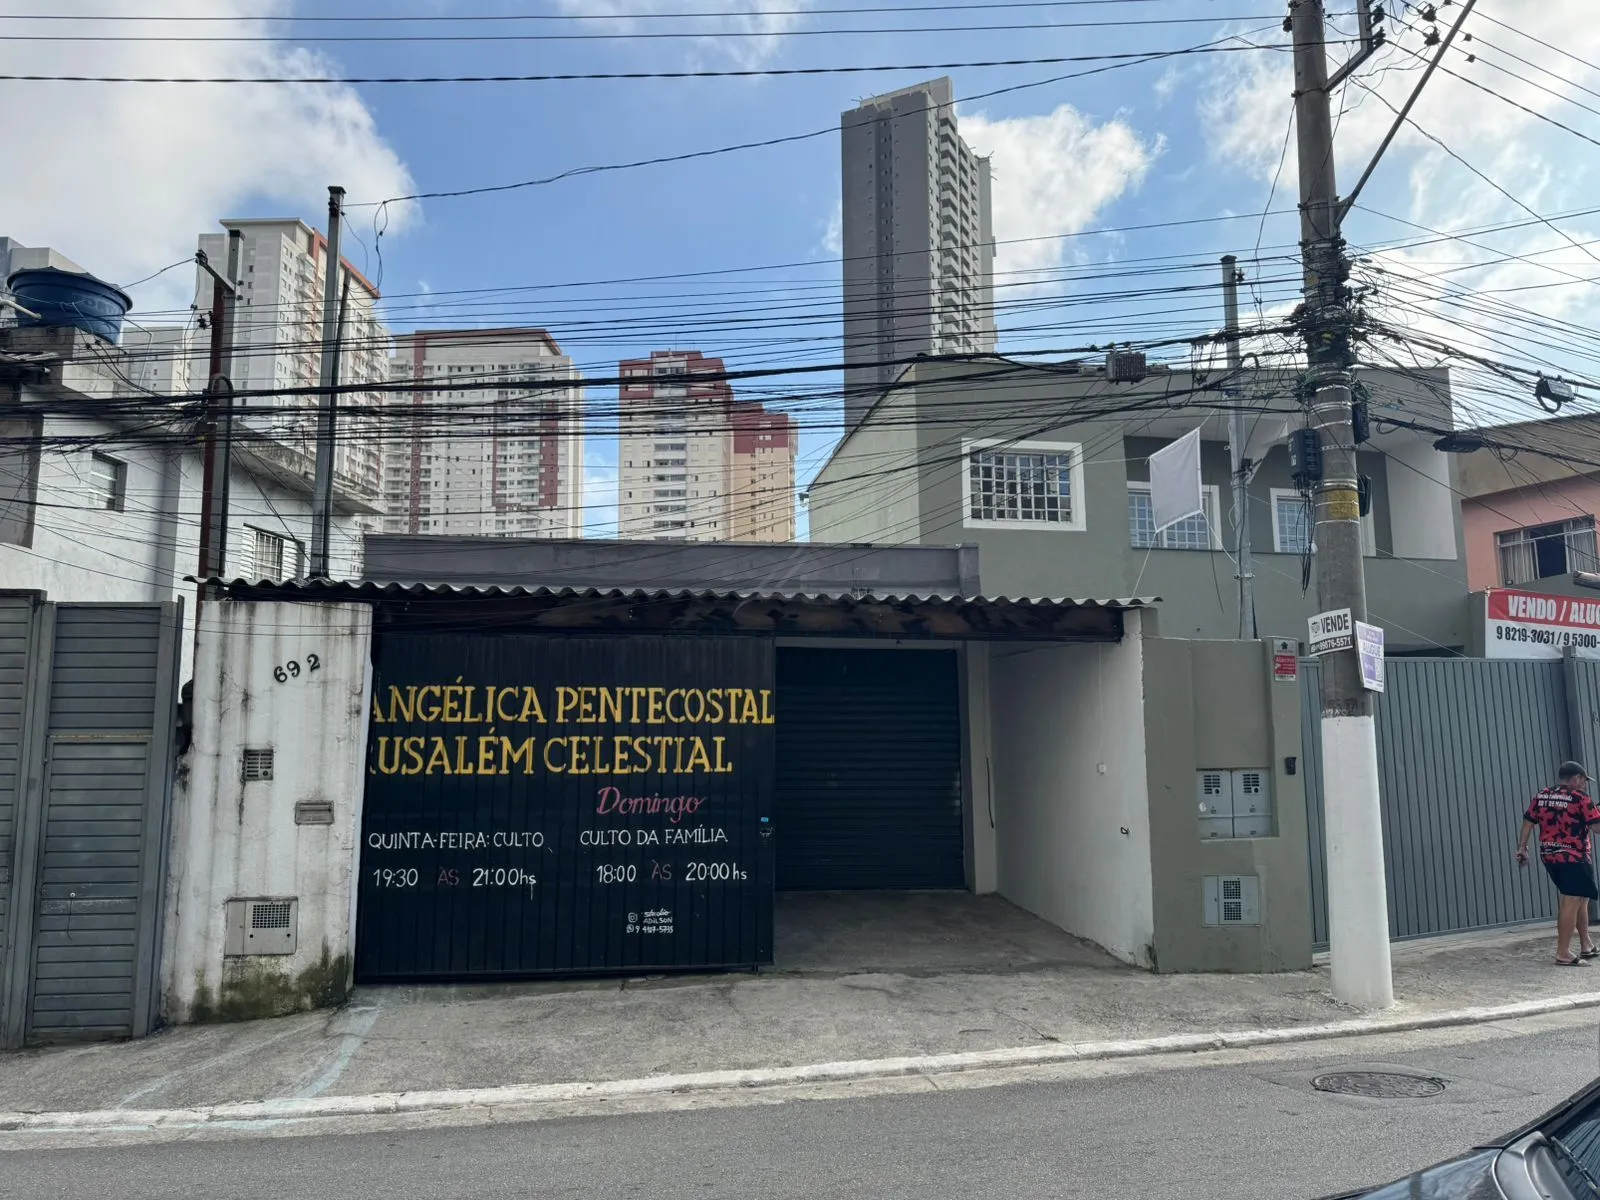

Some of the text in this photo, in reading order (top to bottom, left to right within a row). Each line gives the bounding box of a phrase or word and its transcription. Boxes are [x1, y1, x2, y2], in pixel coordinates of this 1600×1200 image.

[1508, 595, 1557, 620] VENDO
[1321, 613, 1349, 633] VENDE
[1496, 626, 1503, 640] 9
[1504, 627, 1555, 645] 8219-3031
[1563, 633, 1570, 646] 9
[273, 653, 321, 683] 692
[555, 687, 775, 724] PENTECOSTAL
[543, 736, 732, 774] CELESTIAL
[596, 786, 707, 823] Domingo
[368, 832, 544, 850] QUINTA-FEIRA: CULTO
[580, 824, 728, 846] CULTO DA FAMÍLIA
[373, 868, 419, 888] 19:30
[596, 864, 637, 884] 18:00
[651, 859, 673, 881] ÀS
[635, 925, 640, 934] 9
